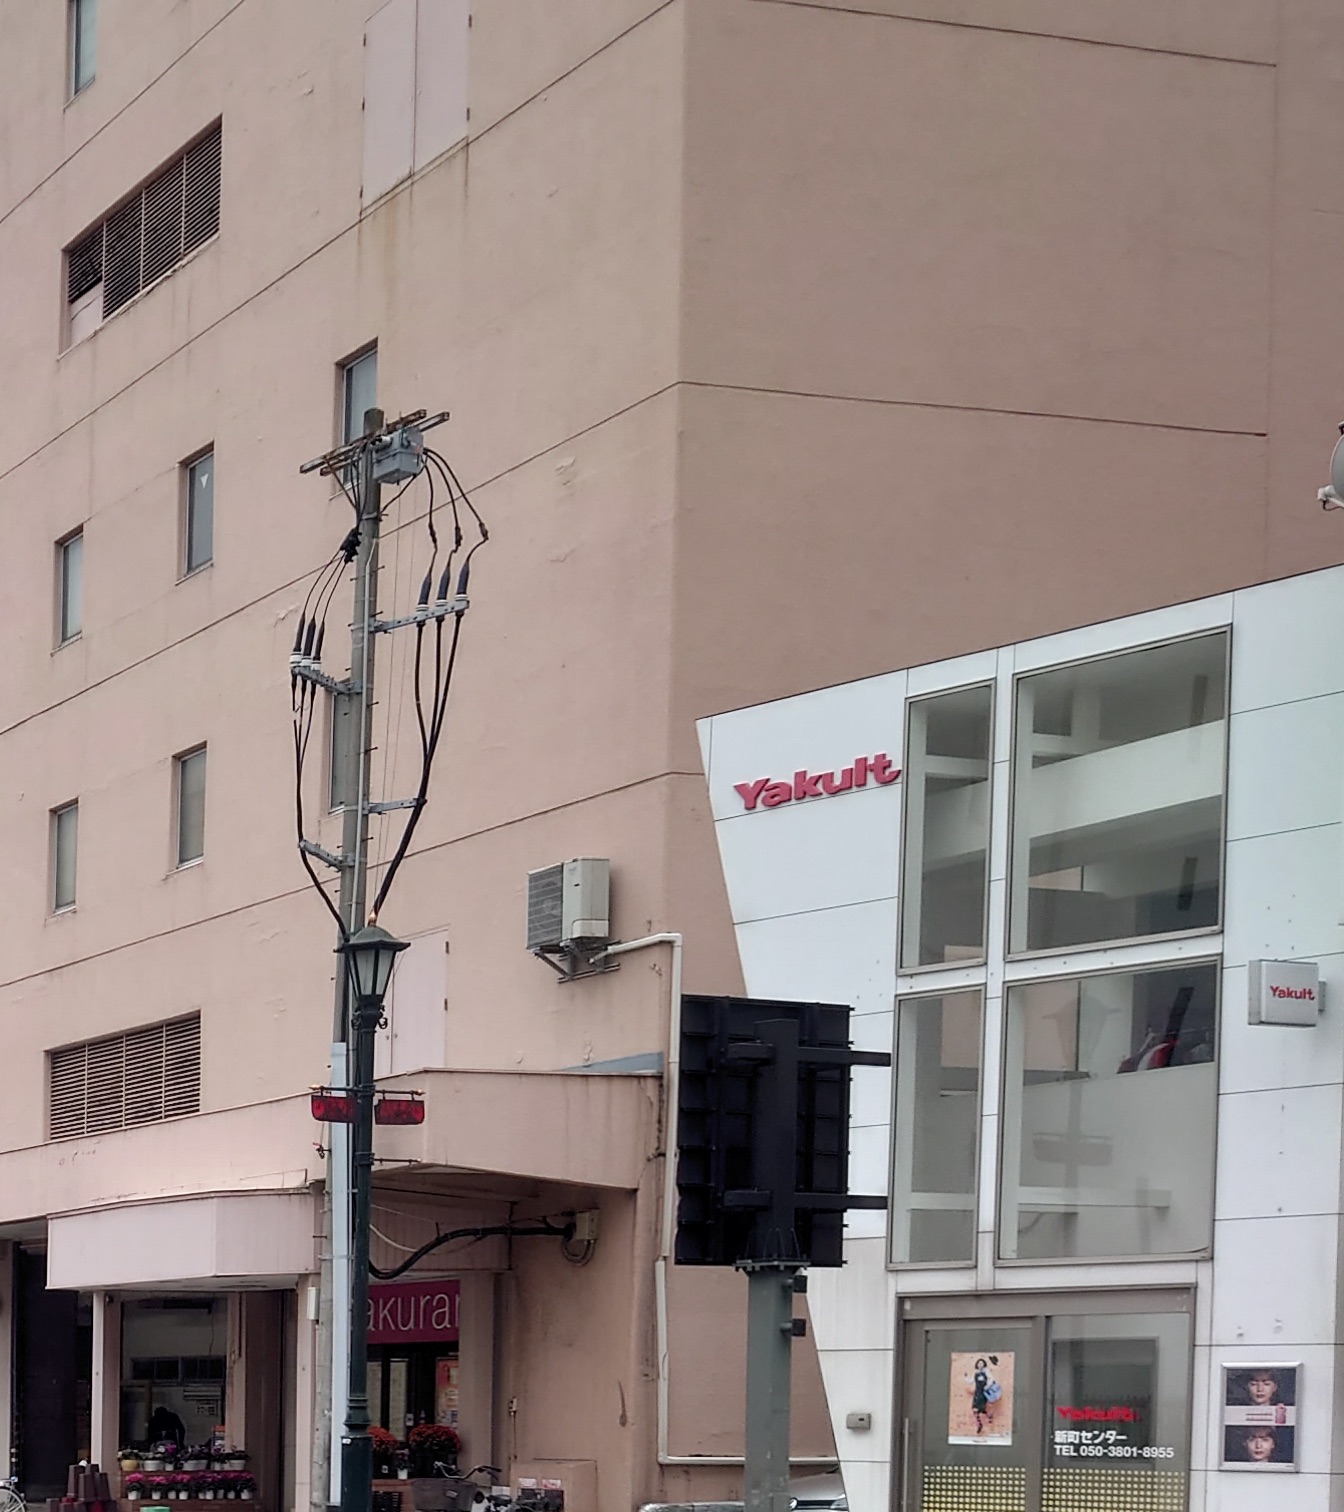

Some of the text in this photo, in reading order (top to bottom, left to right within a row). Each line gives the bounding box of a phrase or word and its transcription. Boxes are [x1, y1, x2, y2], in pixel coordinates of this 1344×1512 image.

[733, 752, 902, 811] Yakult
[1269, 985, 1315, 1001] Yakult
[367, 1294, 459, 1331] kura
[1056, 1406, 1134, 1421] Yakult
[1054, 1430, 1127, 1444] 新町センター
[1054, 1445, 1174, 1458] TEL 050-3801-8955
